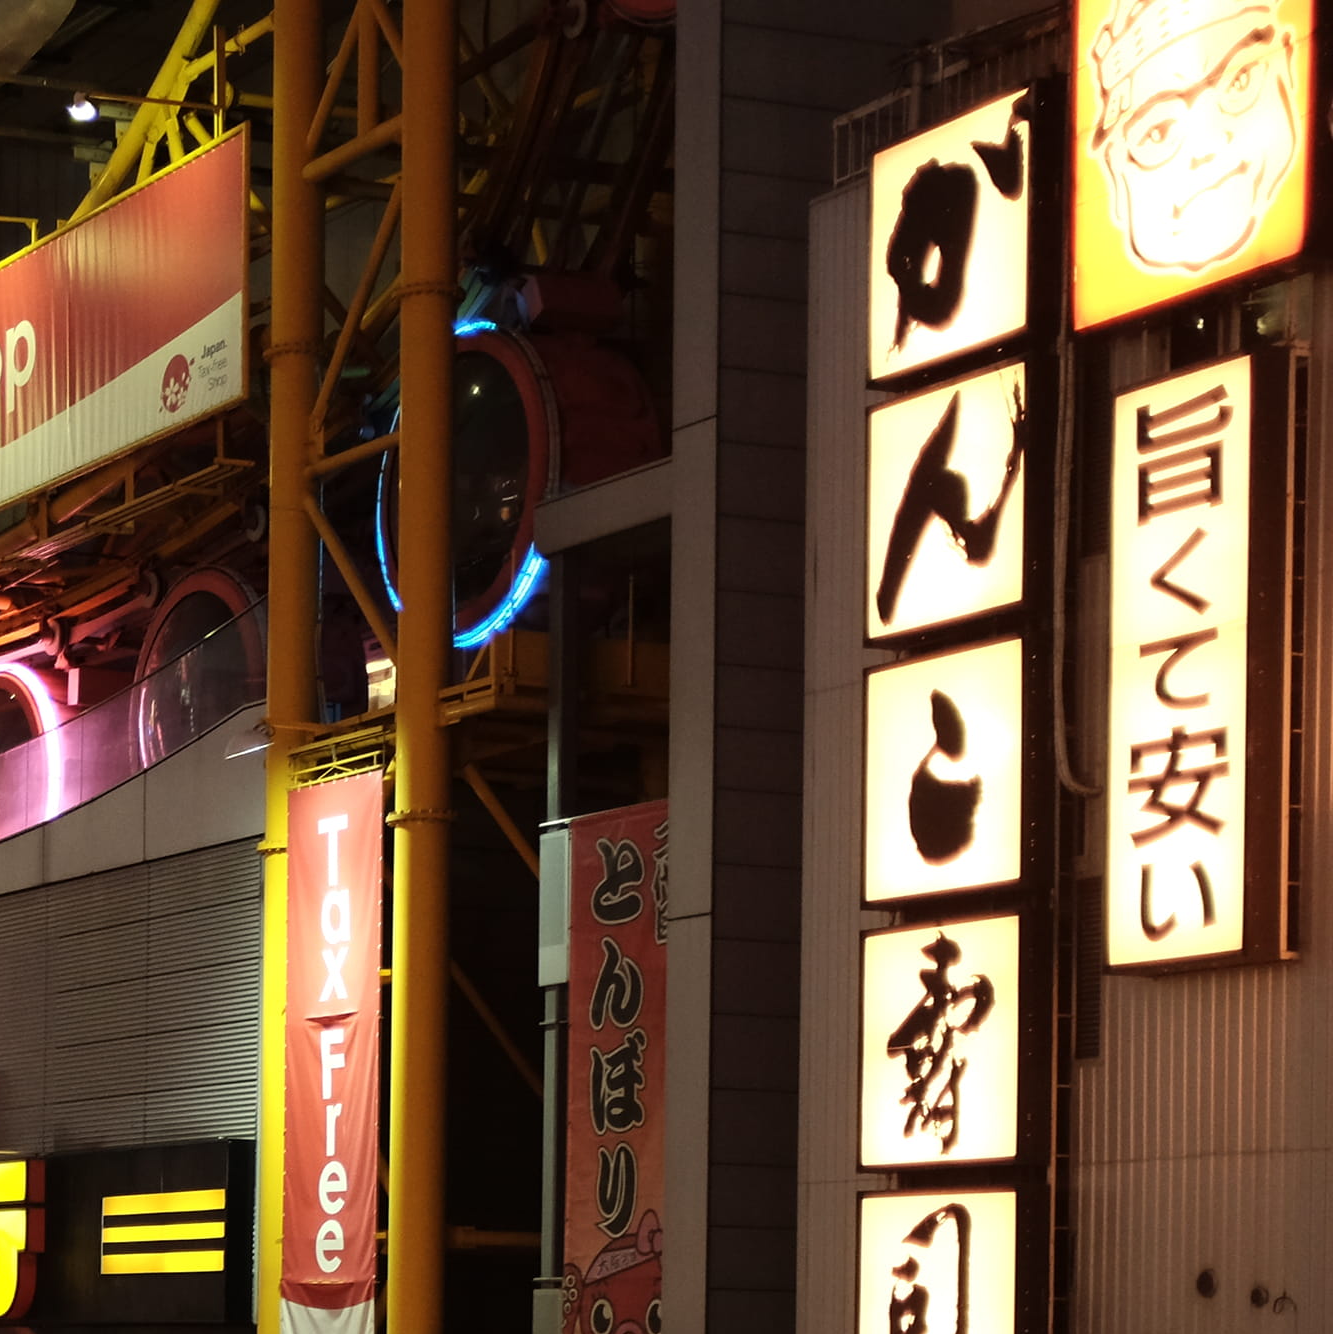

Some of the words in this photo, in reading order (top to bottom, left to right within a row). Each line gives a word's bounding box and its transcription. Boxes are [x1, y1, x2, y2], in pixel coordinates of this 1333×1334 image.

[1127, 384, 1233, 941] 旨くて安い
[317, 813, 348, 1002] Tax
[590, 838, 645, 1239] とんぼり
[314, 1029, 345, 1275] Free
